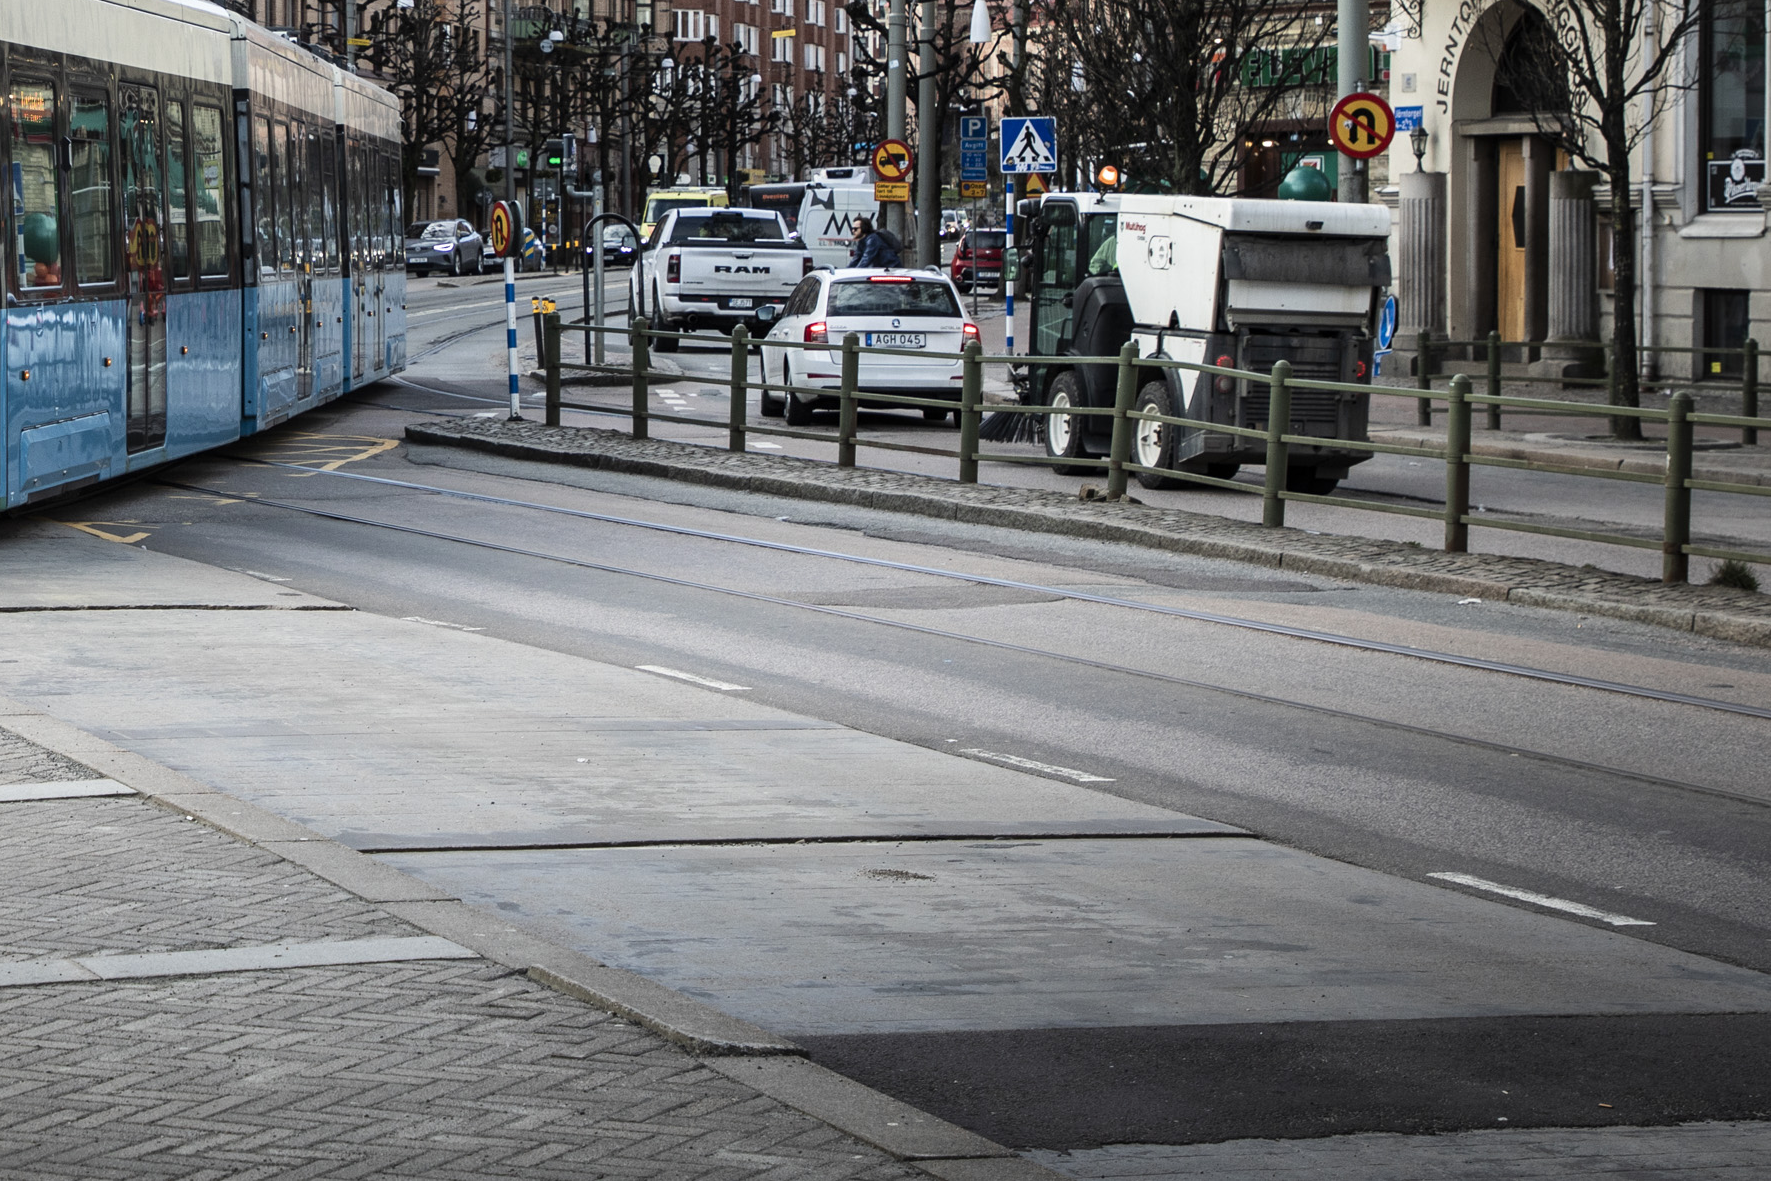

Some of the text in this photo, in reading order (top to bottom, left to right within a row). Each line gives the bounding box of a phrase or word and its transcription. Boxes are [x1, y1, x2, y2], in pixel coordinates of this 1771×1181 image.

[969, 120, 981, 136] P
[1125, 222, 1146, 234] Multihog
[715, 265, 770, 274] RAM
[875, 334, 921, 344] AGH 045
